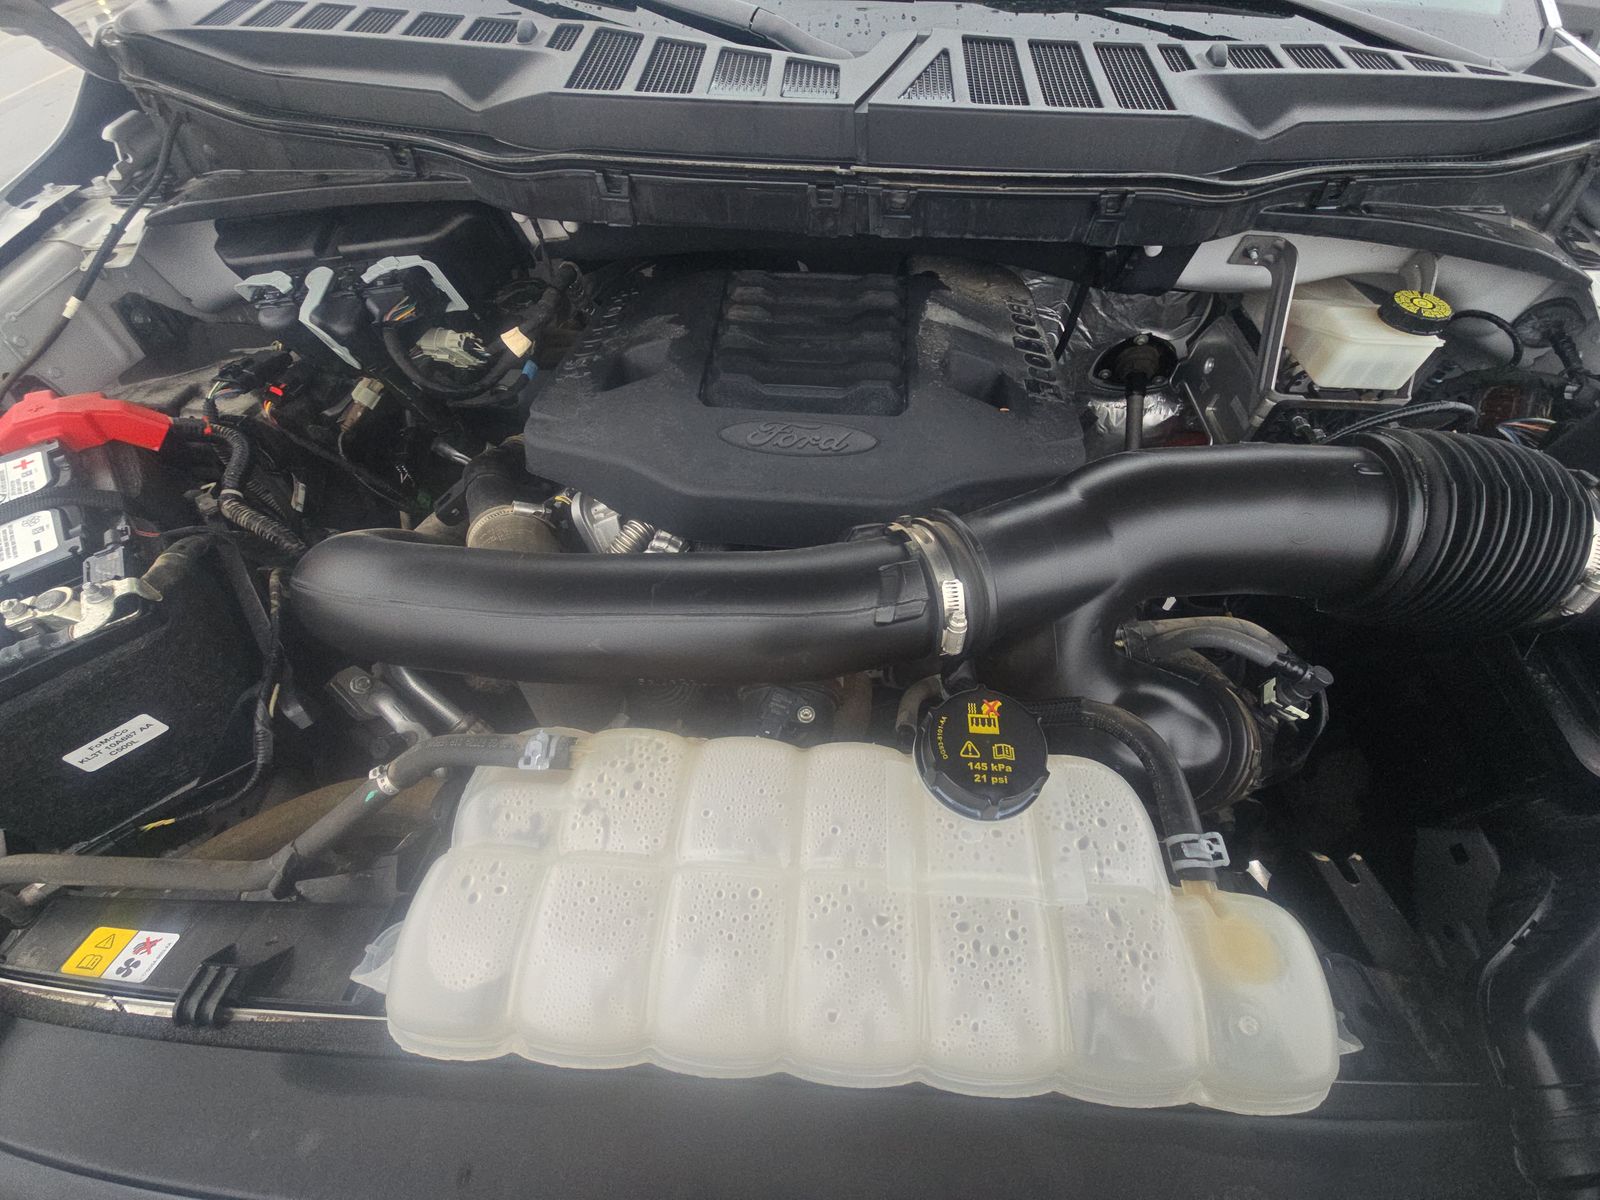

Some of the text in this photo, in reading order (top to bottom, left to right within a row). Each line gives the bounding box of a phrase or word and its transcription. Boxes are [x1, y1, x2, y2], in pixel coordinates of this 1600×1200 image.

[746, 422, 852, 452] Ford
[78, 750, 103, 765] KL3T
[139, 723, 154, 732] AA
[88, 728, 129, 752] FoMoCo
[968, 761, 1013, 773] 145 kPa
[974, 774, 1008, 785] 21 psi
